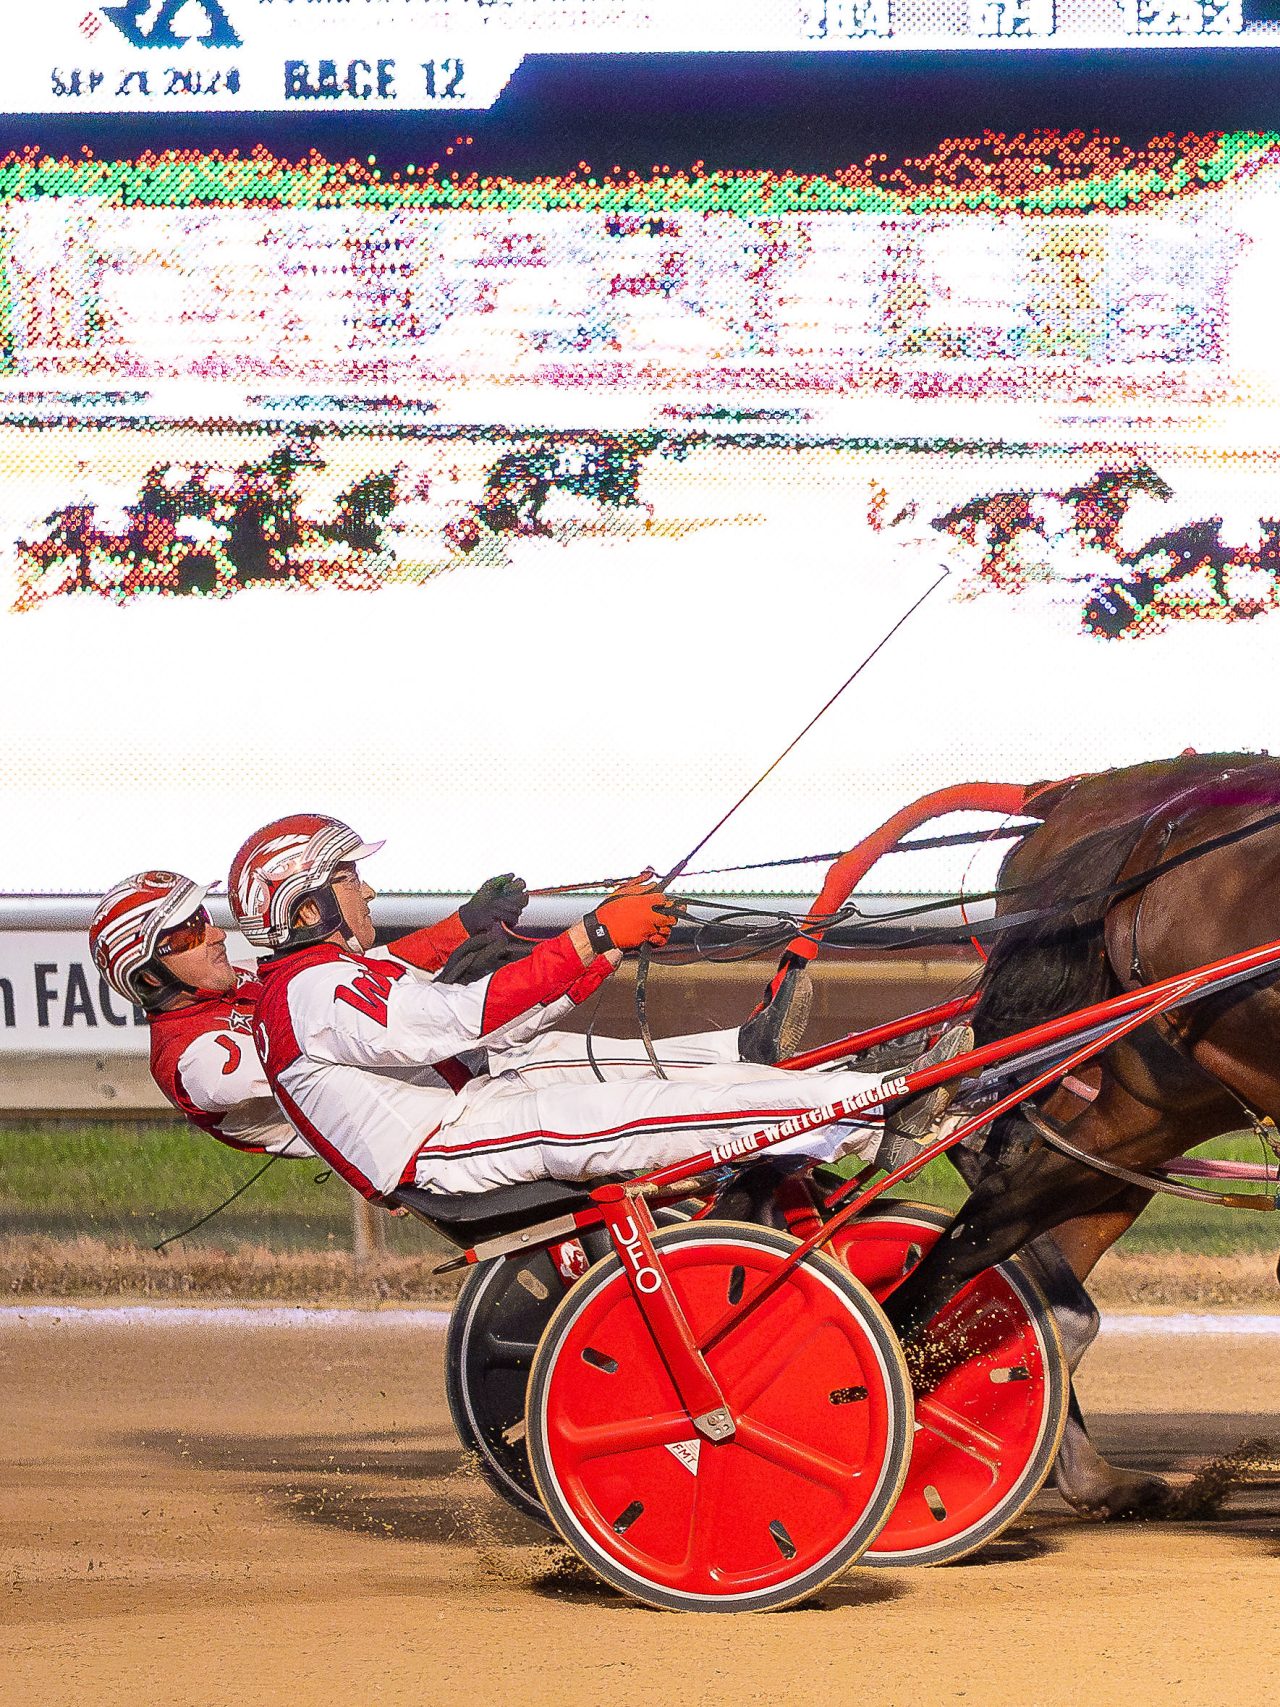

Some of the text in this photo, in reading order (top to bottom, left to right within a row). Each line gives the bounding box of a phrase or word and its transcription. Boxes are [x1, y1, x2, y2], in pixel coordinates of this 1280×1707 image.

[284, 58, 466, 101] RACE 12
[711, 1075, 910, 1164] Todd Warren Racing
[611, 1215, 662, 1294] UFO
[672, 1443, 698, 1463] FMT
